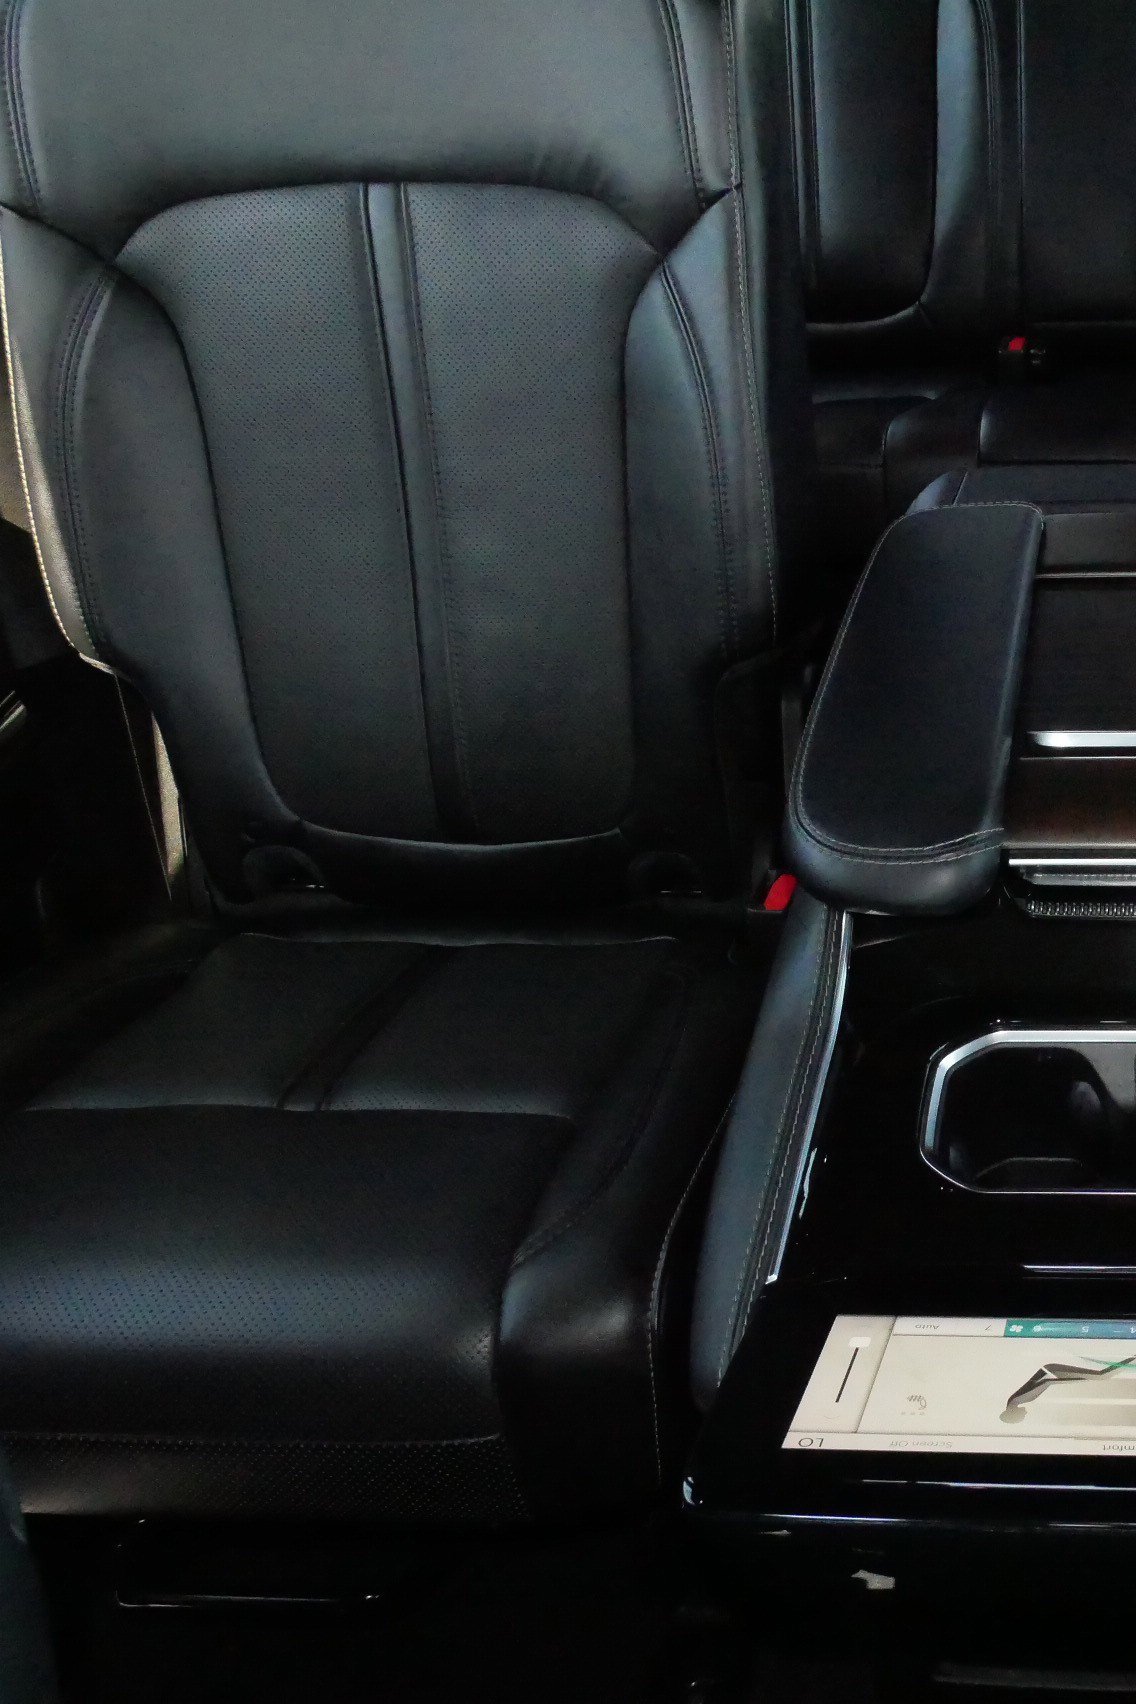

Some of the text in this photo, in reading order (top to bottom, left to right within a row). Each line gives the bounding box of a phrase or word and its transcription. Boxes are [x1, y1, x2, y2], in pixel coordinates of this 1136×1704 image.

[914, 1323, 940, 1331] Auto
[1081, 1325, 1090, 1333] 5
[798, 1437, 824, 1448] LO
[888, 1440, 953, 1449] Screen Off
